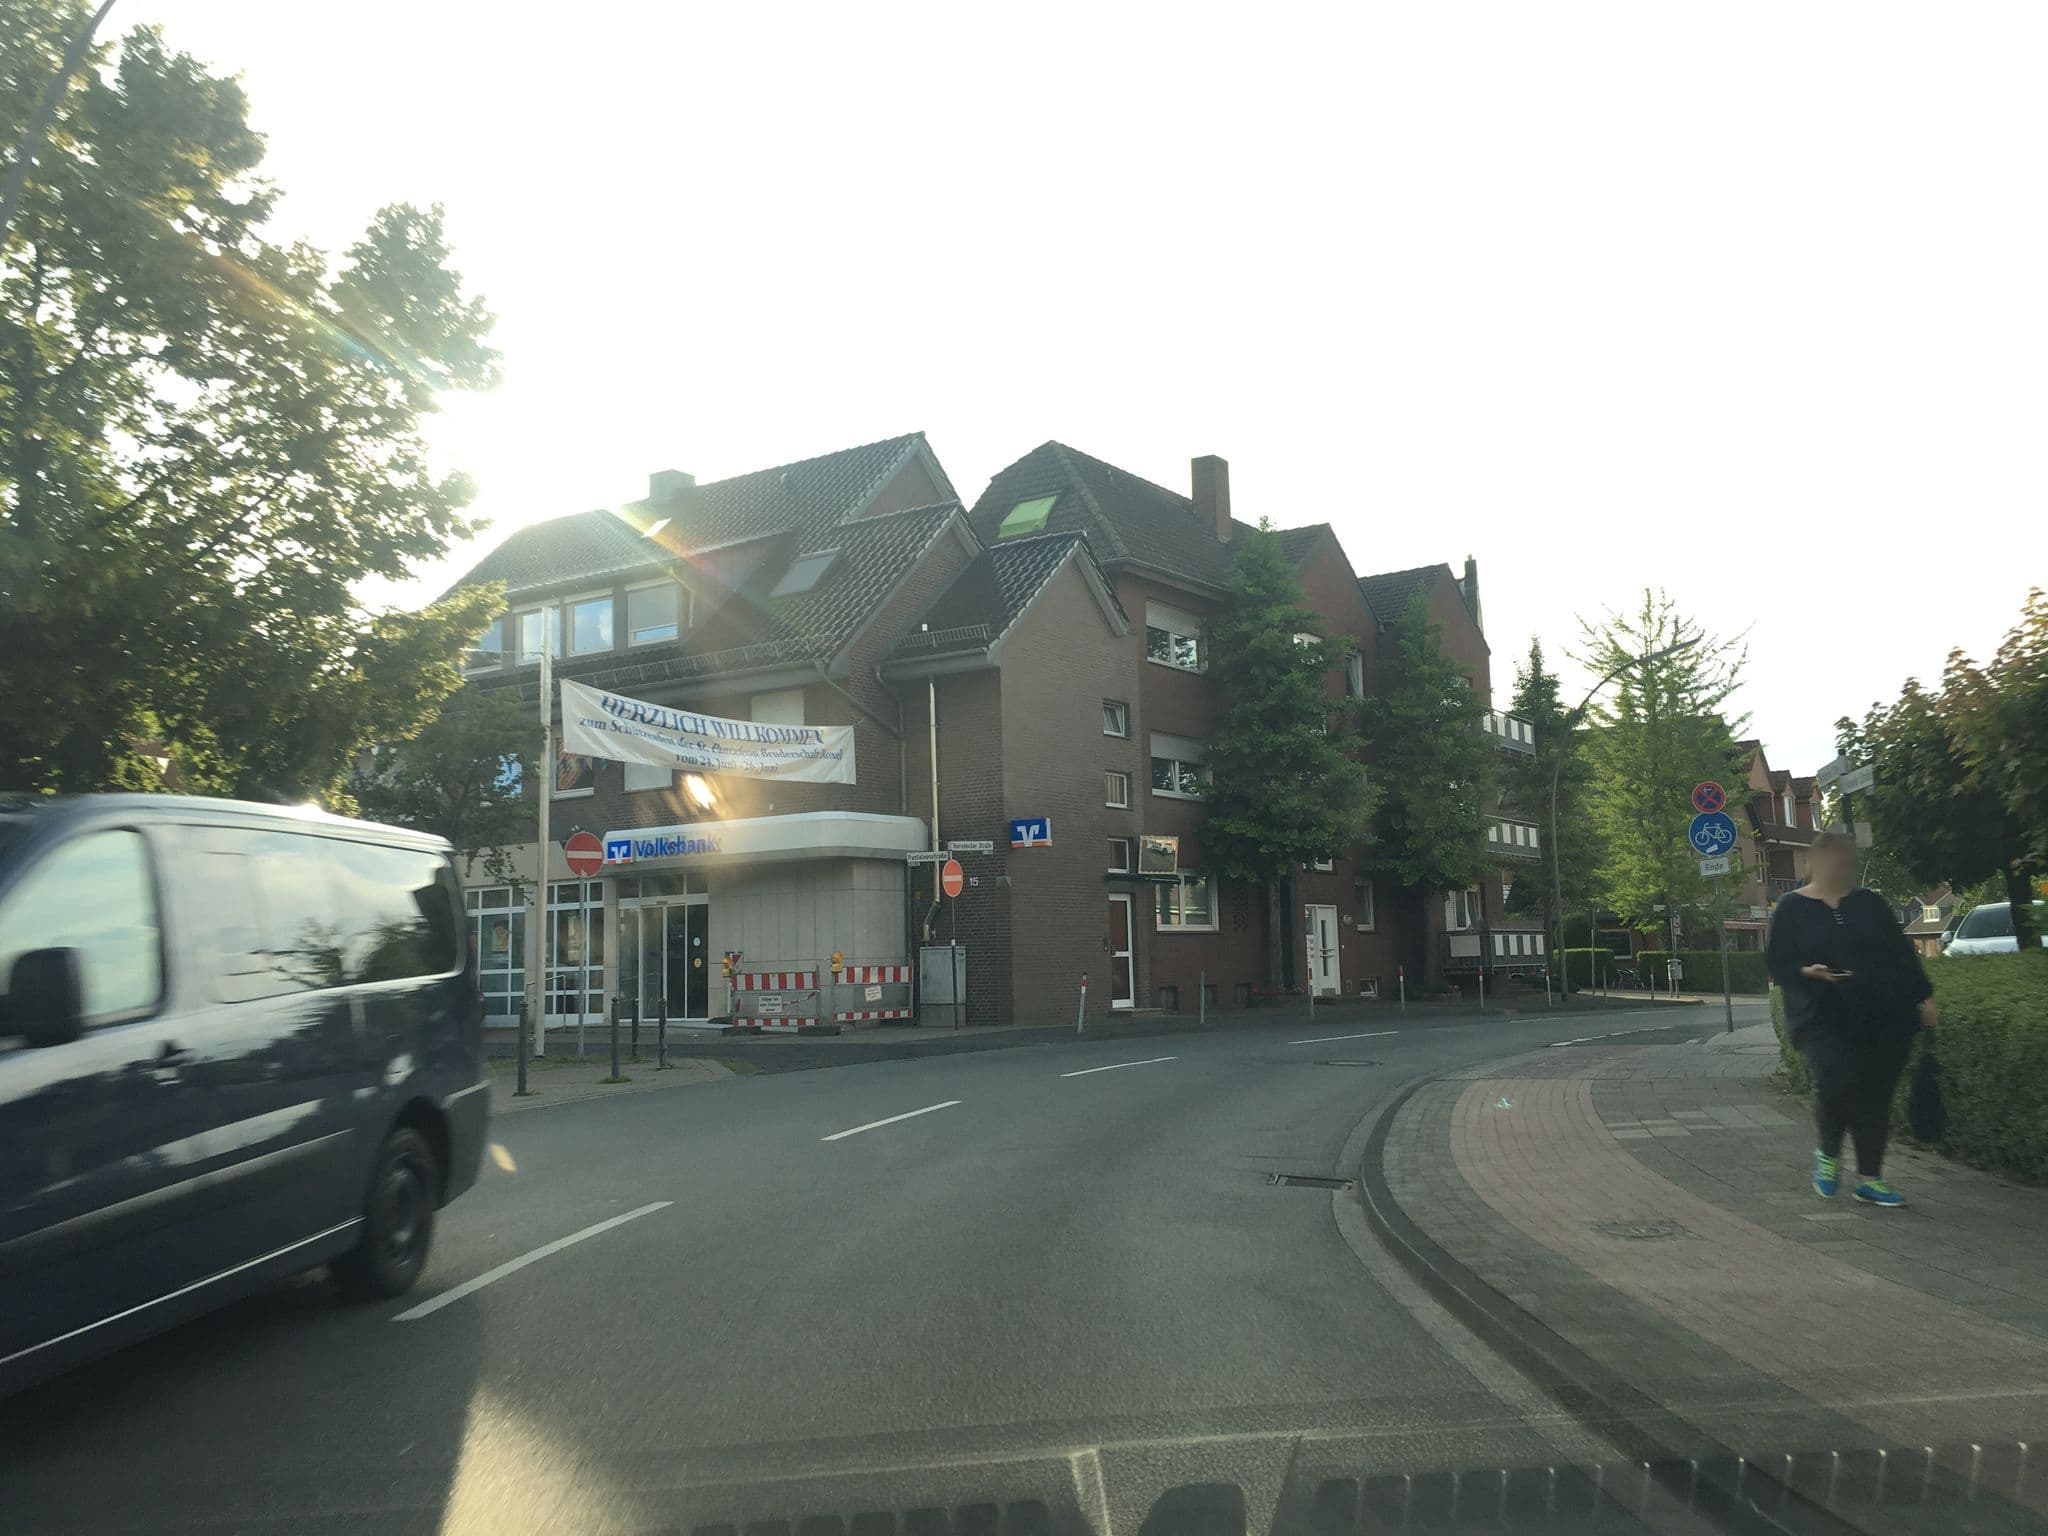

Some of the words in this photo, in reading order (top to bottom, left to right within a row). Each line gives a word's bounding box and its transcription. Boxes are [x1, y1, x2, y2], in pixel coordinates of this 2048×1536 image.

[602, 695, 708, 736] HERZLICH
[711, 720, 825, 745] WILLKOMMEN
[580, 718, 606, 731] zum
[677, 737, 694, 749] der
[676, 754, 698, 765] vom
[714, 758, 736, 771] Juni
[757, 762, 779, 775] Juni
[635, 835, 719, 858] Volksbank
[1704, 863, 1724, 871] Ende
[969, 877, 979, 887] 15
